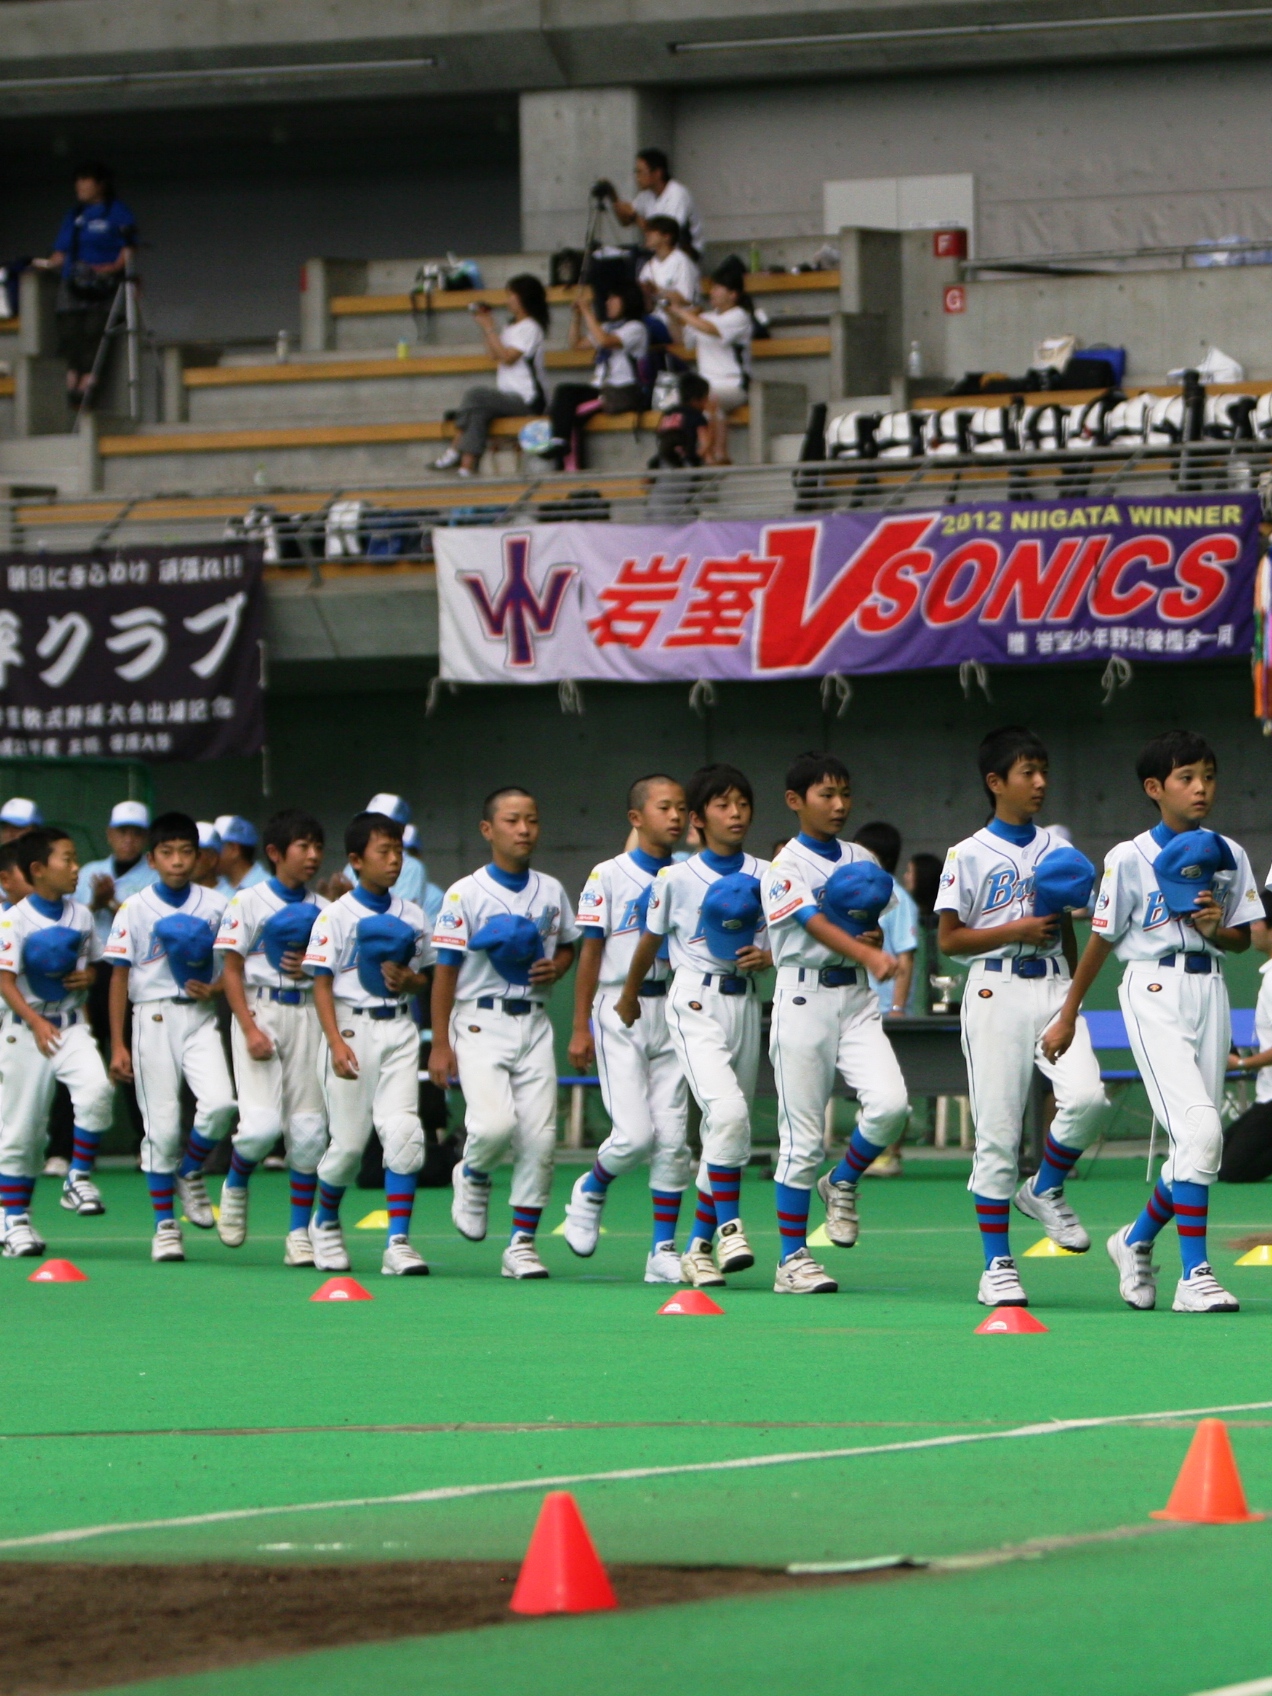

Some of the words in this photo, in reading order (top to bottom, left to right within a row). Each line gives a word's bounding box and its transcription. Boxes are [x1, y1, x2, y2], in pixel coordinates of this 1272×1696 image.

[946, 288, 961, 311] G
[941, 512, 1003, 534] 2012
[1010, 505, 1121, 531] NIIGATA
[1128, 505, 1241, 527] WINNER
[586, 552, 780, 650] 岩室
